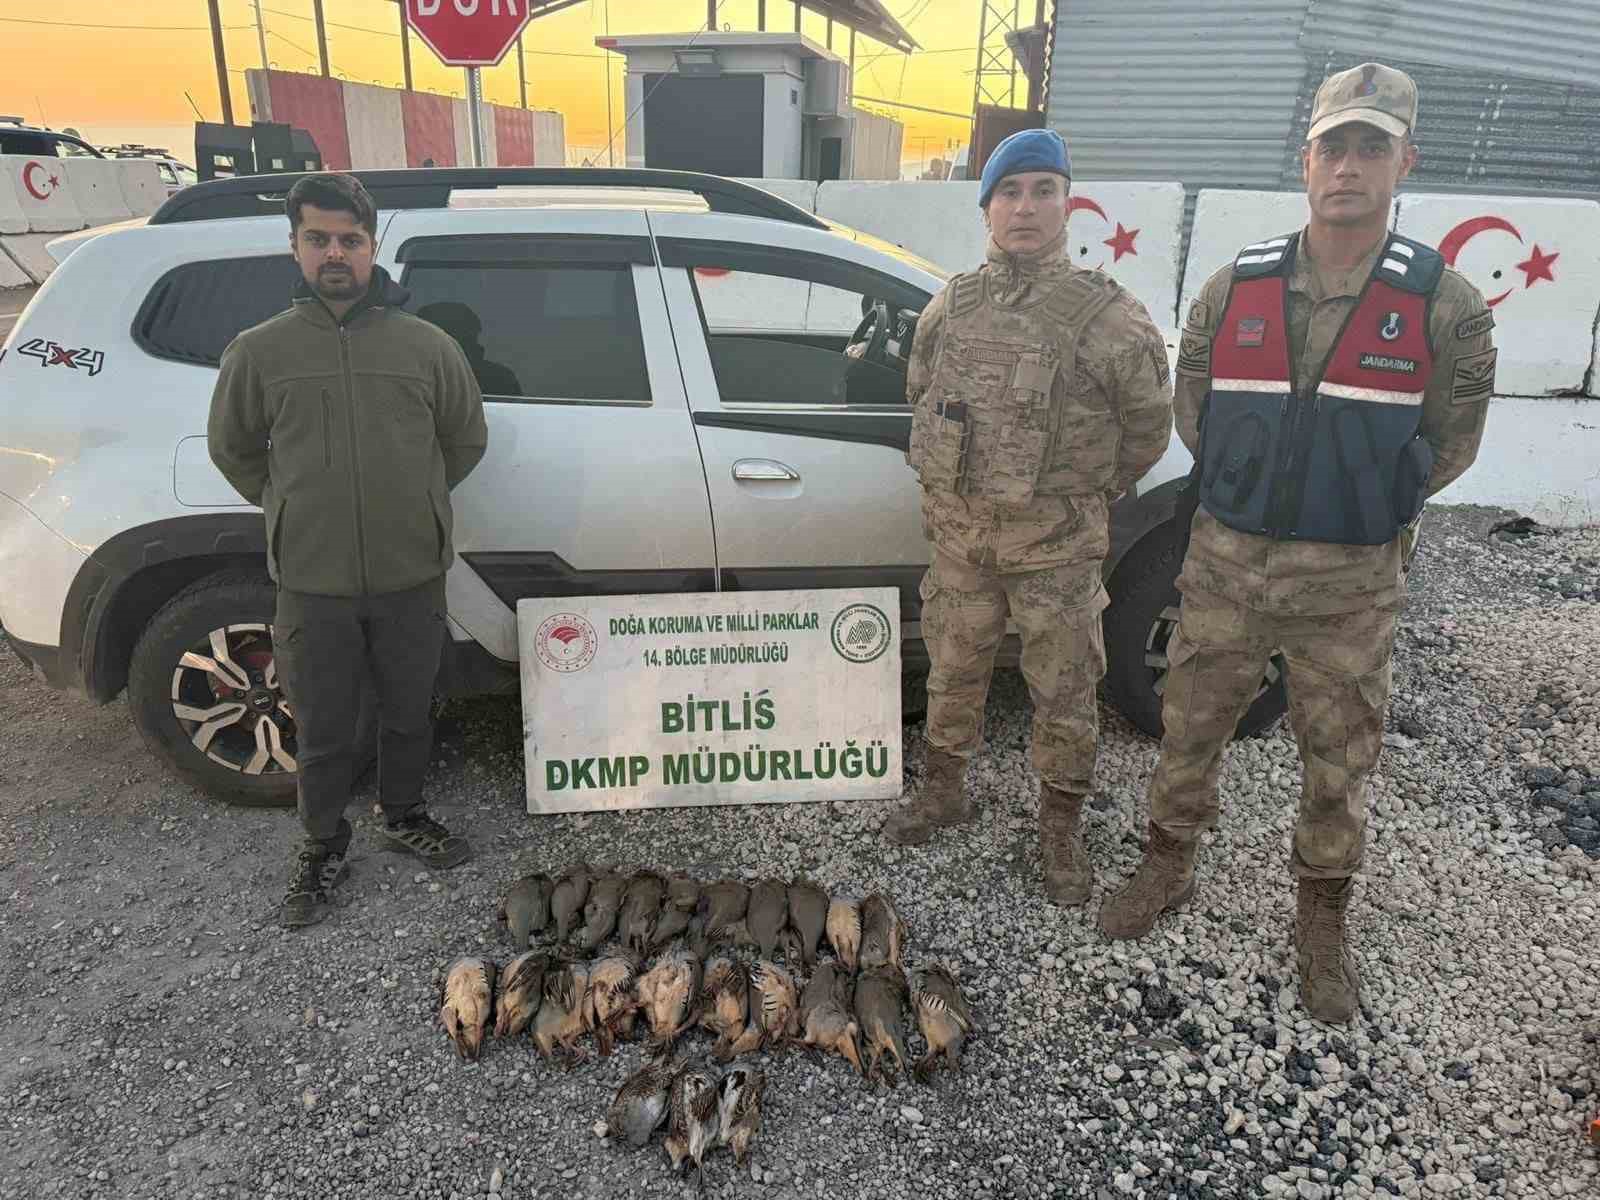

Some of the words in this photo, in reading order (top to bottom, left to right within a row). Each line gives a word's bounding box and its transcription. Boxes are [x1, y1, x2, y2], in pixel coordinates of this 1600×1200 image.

[1361, 355, 1415, 372] JANDARMA
[610, 614, 646, 636] DOĞA
[649, 615, 703, 635] KORUMA
[706, 614, 723, 633] VE
[726, 610, 760, 633] MİLLİ
[762, 612, 820, 631] PARKLAR
[643, 649, 662, 668] 14.
[665, 646, 707, 666] BÖLGE
[710, 641, 789, 665] MÜDÜRLÜĞÜ
[545, 755, 650, 792] DKMP
[662, 740, 888, 786] MÜDÜRLÜĞÜ
